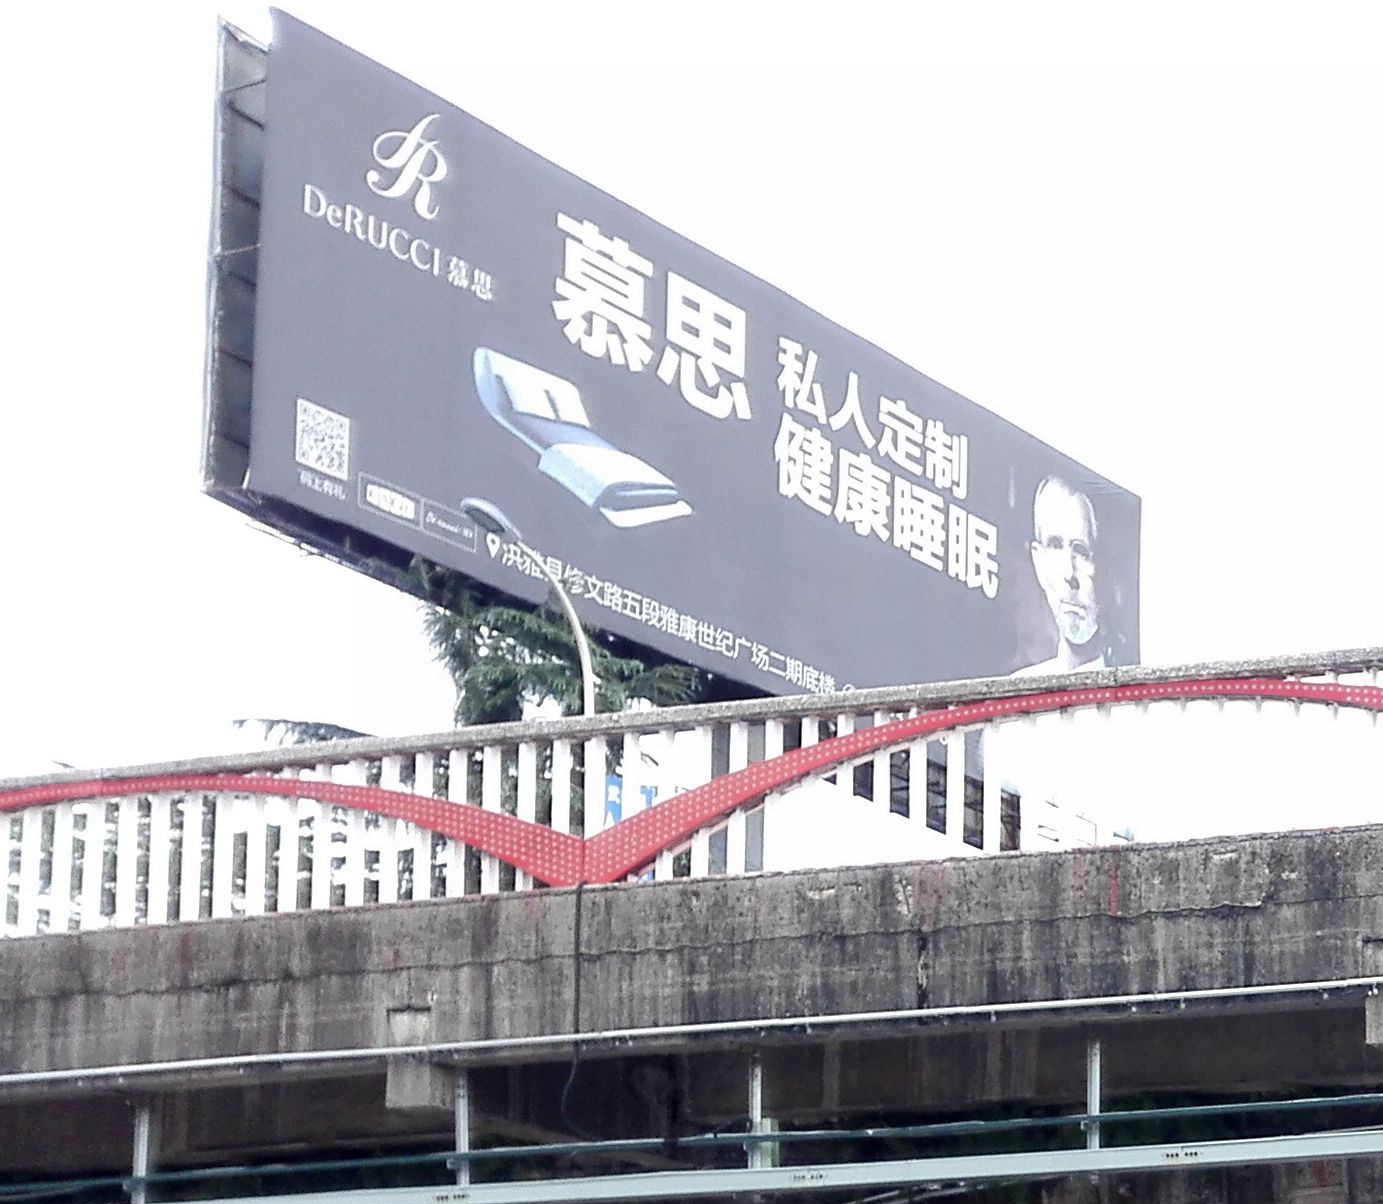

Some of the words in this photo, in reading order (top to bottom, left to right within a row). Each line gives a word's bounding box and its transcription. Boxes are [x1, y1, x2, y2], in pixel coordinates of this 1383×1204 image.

[303, 183, 441, 277] DeRUCCI
[448, 256, 494, 301] 慕思
[552, 212, 752, 420] 慕思
[774, 412, 999, 600] 健康睡眠
[776, 336, 968, 500] 私人定制
